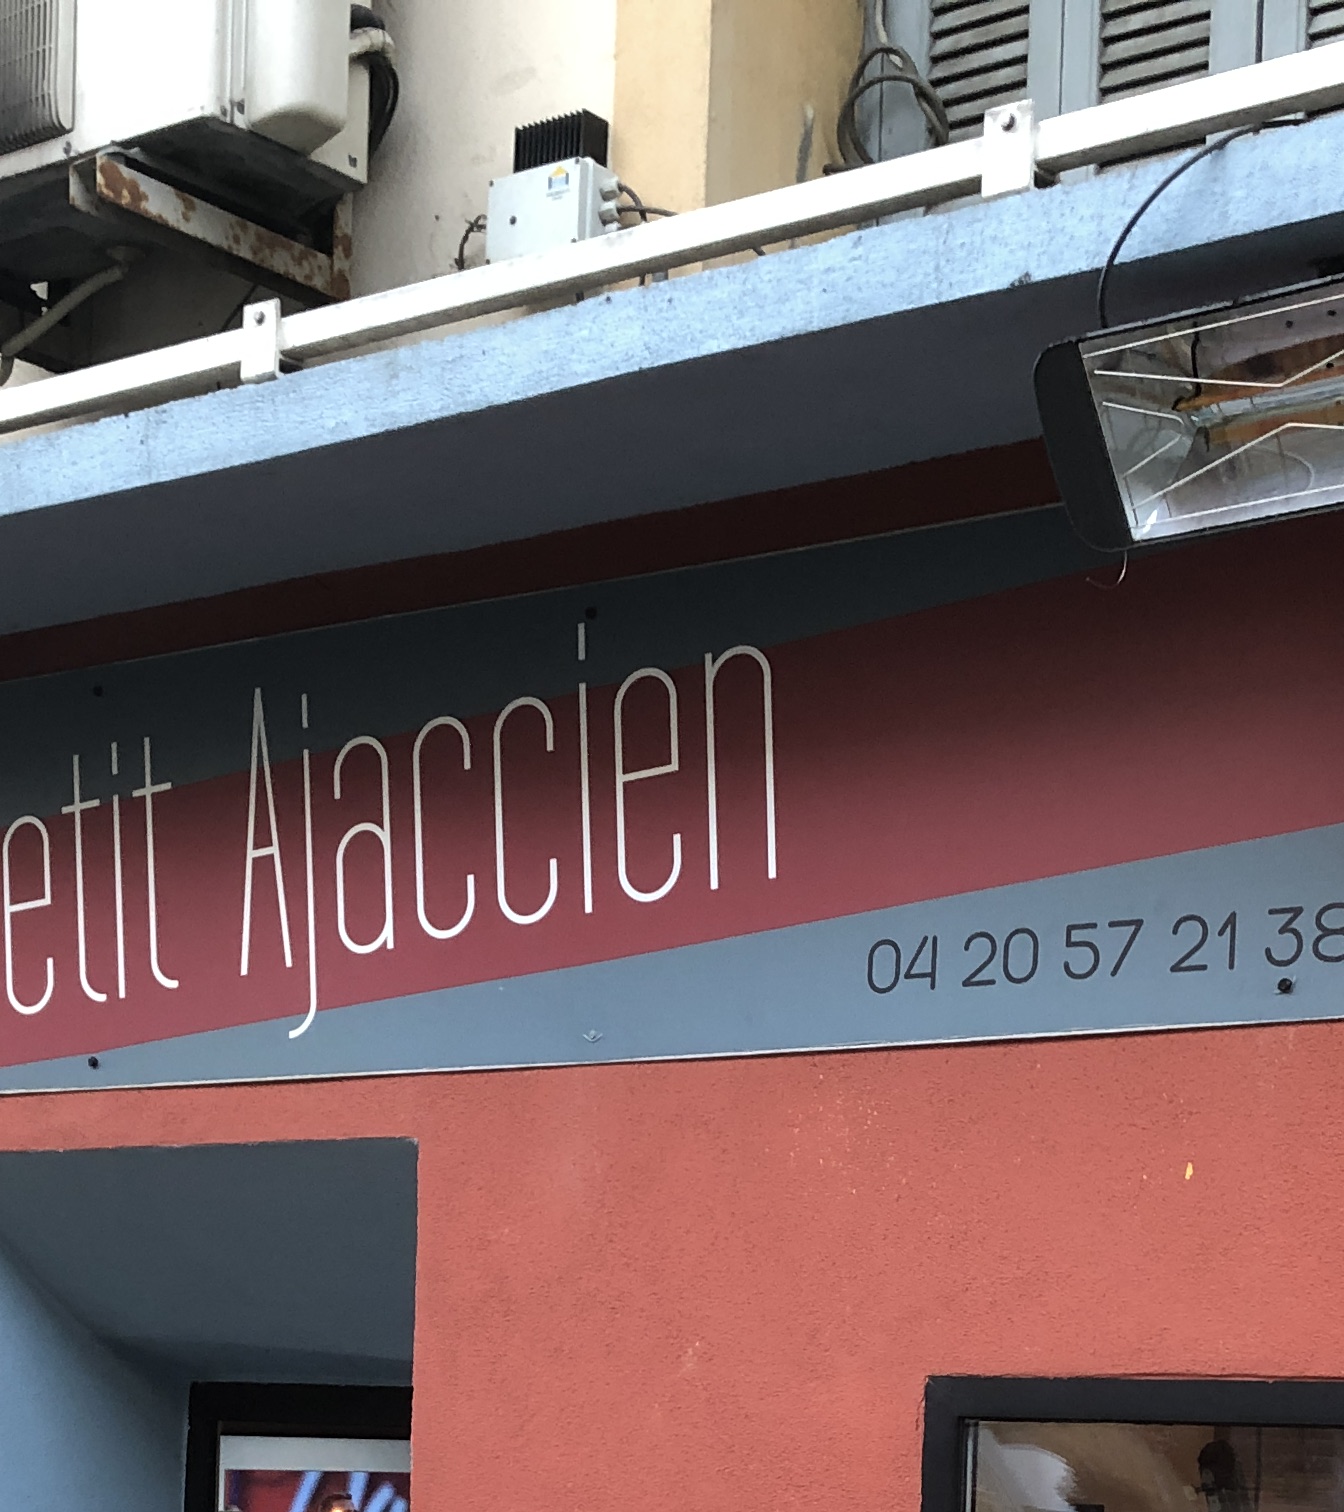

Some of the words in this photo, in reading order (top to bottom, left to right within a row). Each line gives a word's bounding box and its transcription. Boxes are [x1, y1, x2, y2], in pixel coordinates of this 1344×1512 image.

[240, 621, 777, 1039] Ajaccien
[866, 934, 939, 994] 04
[961, 926, 1041, 988] 20
[1062, 917, 1145, 980] 57
[1169, 910, 1239, 973] 21
